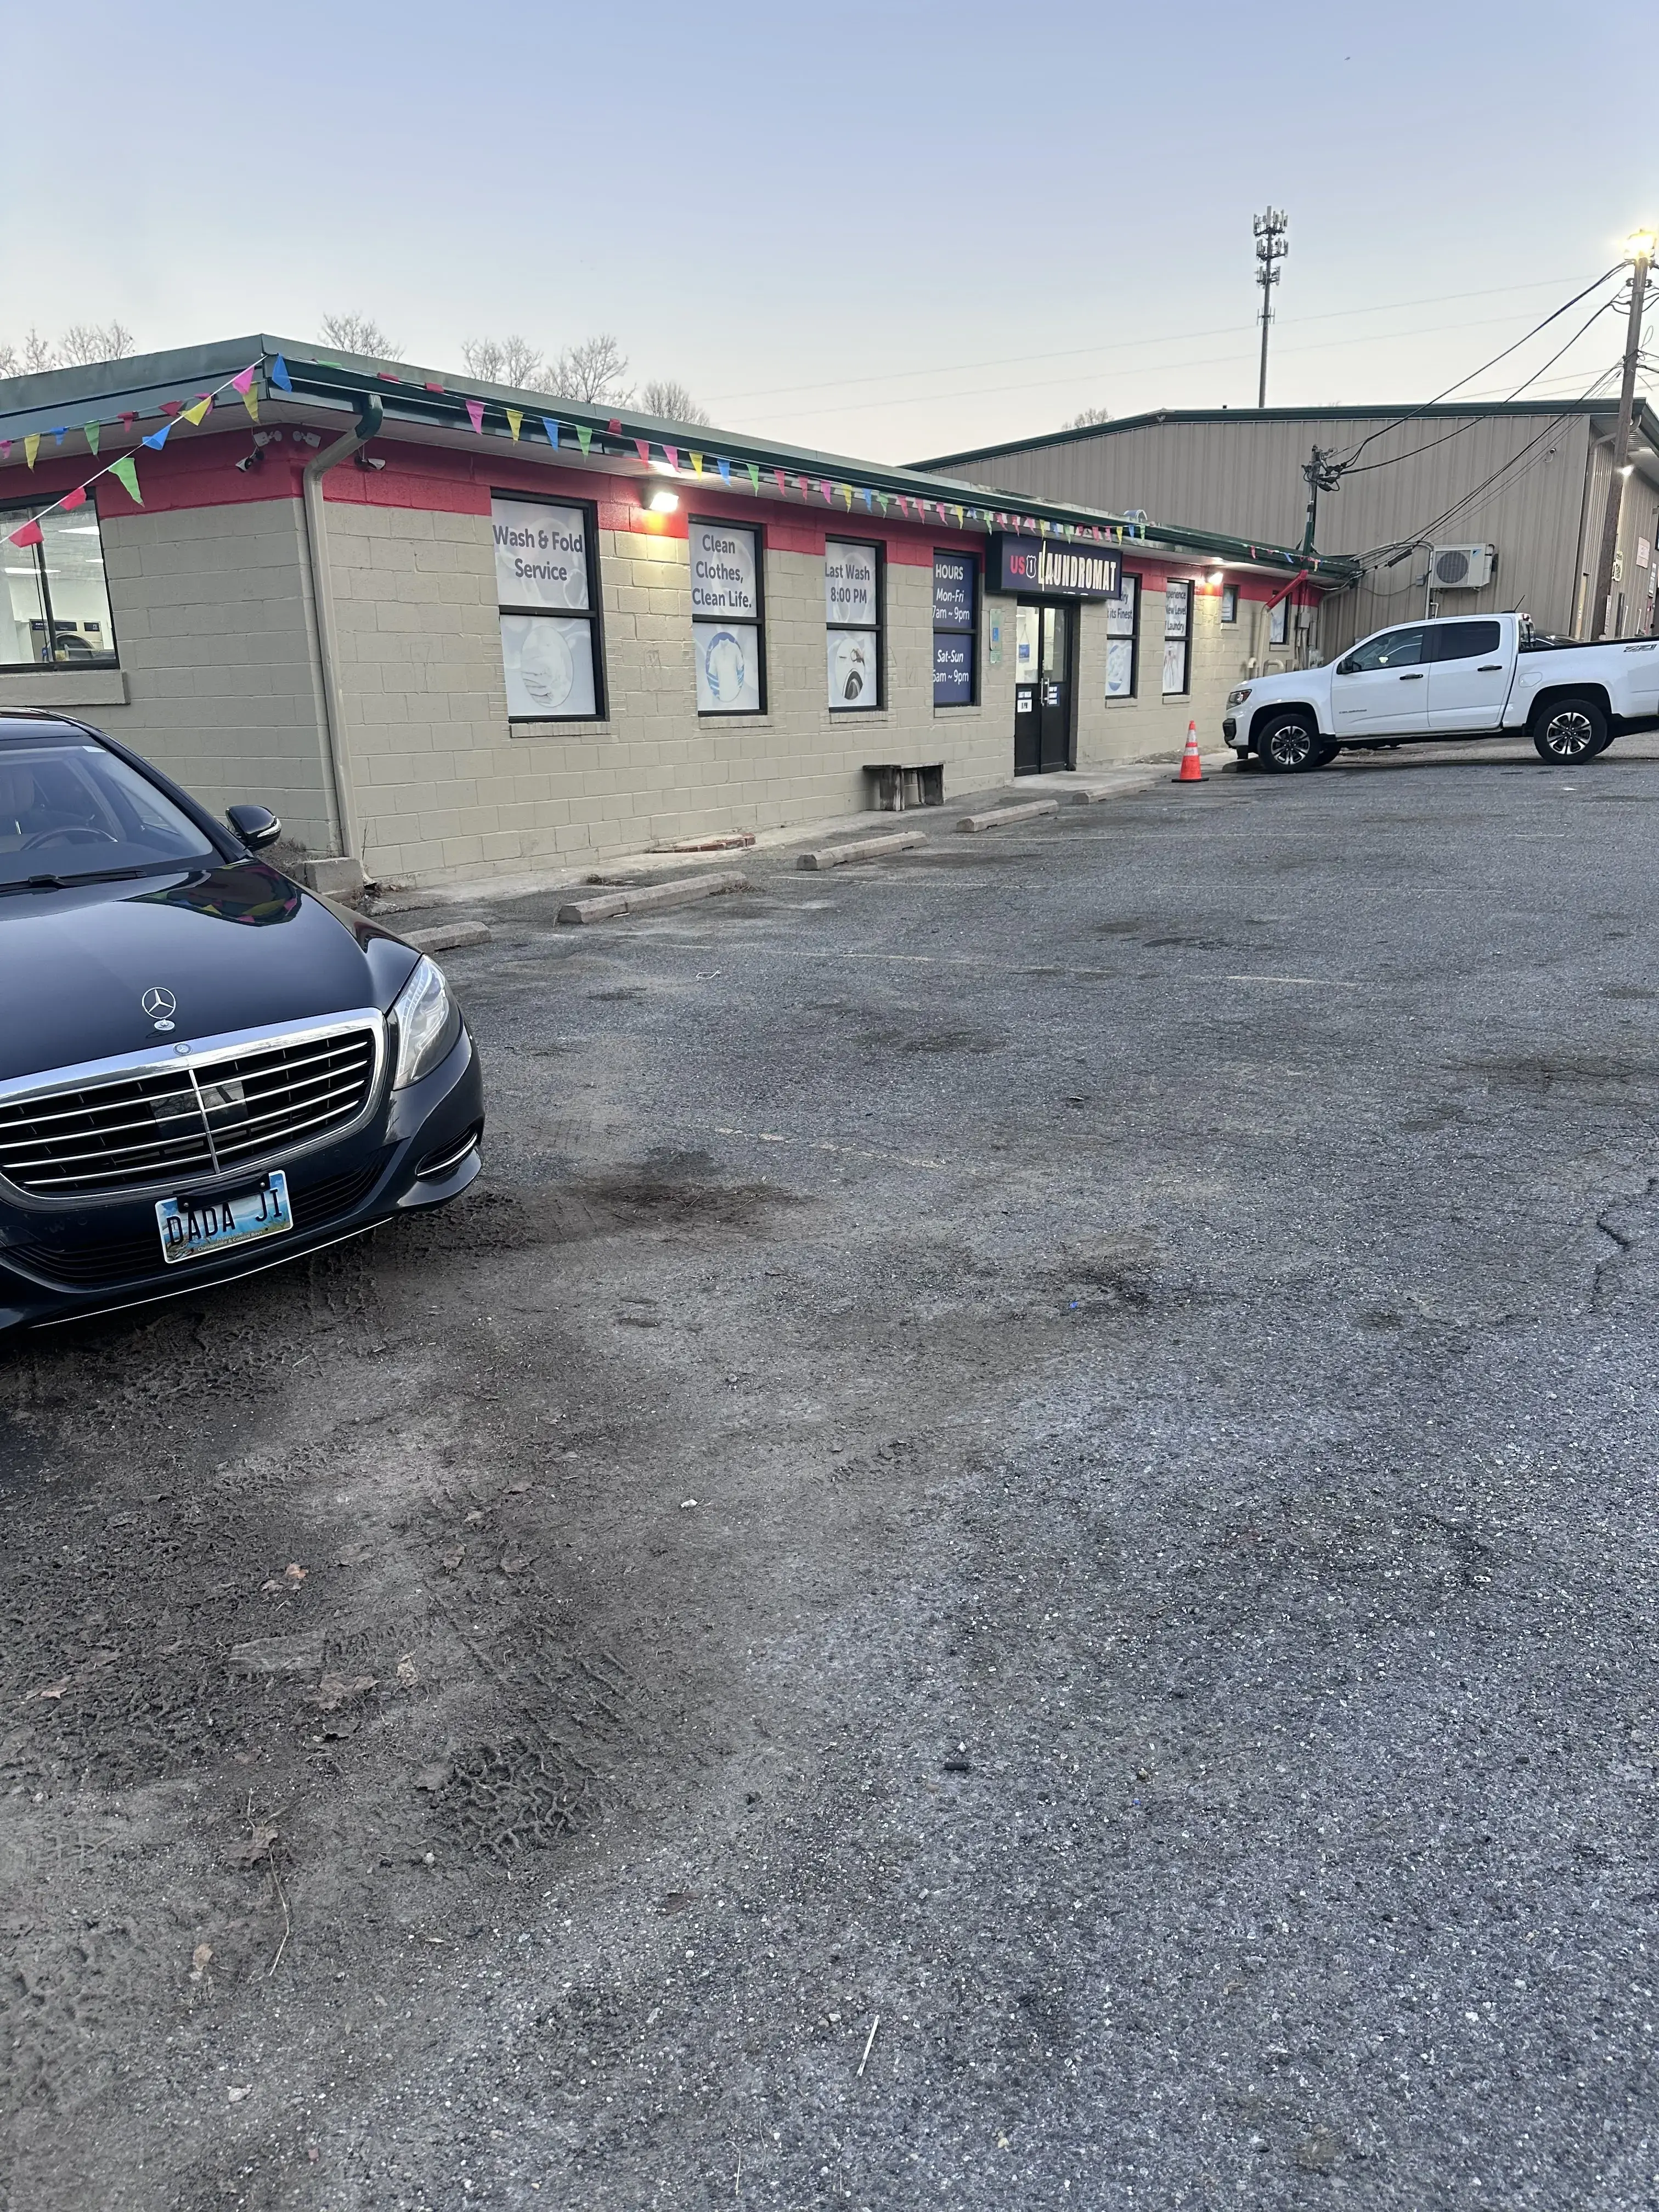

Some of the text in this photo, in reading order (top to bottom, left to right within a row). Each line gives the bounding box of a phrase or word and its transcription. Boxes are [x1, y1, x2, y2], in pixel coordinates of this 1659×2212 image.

[493, 525, 583, 553] Wash & Fold
[702, 534, 736, 554] Clean
[515, 558, 567, 581] Service
[696, 561, 743, 584] Clothes,
[825, 562, 870, 580] Last Wash
[935, 564, 963, 580] HOURS
[1010, 555, 1025, 574] US
[1038, 551, 1116, 591] LAUNDROMAT
[692, 588, 752, 608] Clean Life.
[831, 586, 867, 604] 8:00 PM
[936, 588, 964, 602] Mon-Fri
[932, 605, 947, 618] 7am
[954, 606, 970, 623] 9pm
[1118, 608, 1132, 619] Finest
[1175, 605, 1186, 616] Level
[1167, 620, 1184, 633] Laundry
[937, 650, 964, 663] Sat-Sun
[953, 669, 969, 685] 9pm
[166, 1188, 283, 1245] DADA JI
